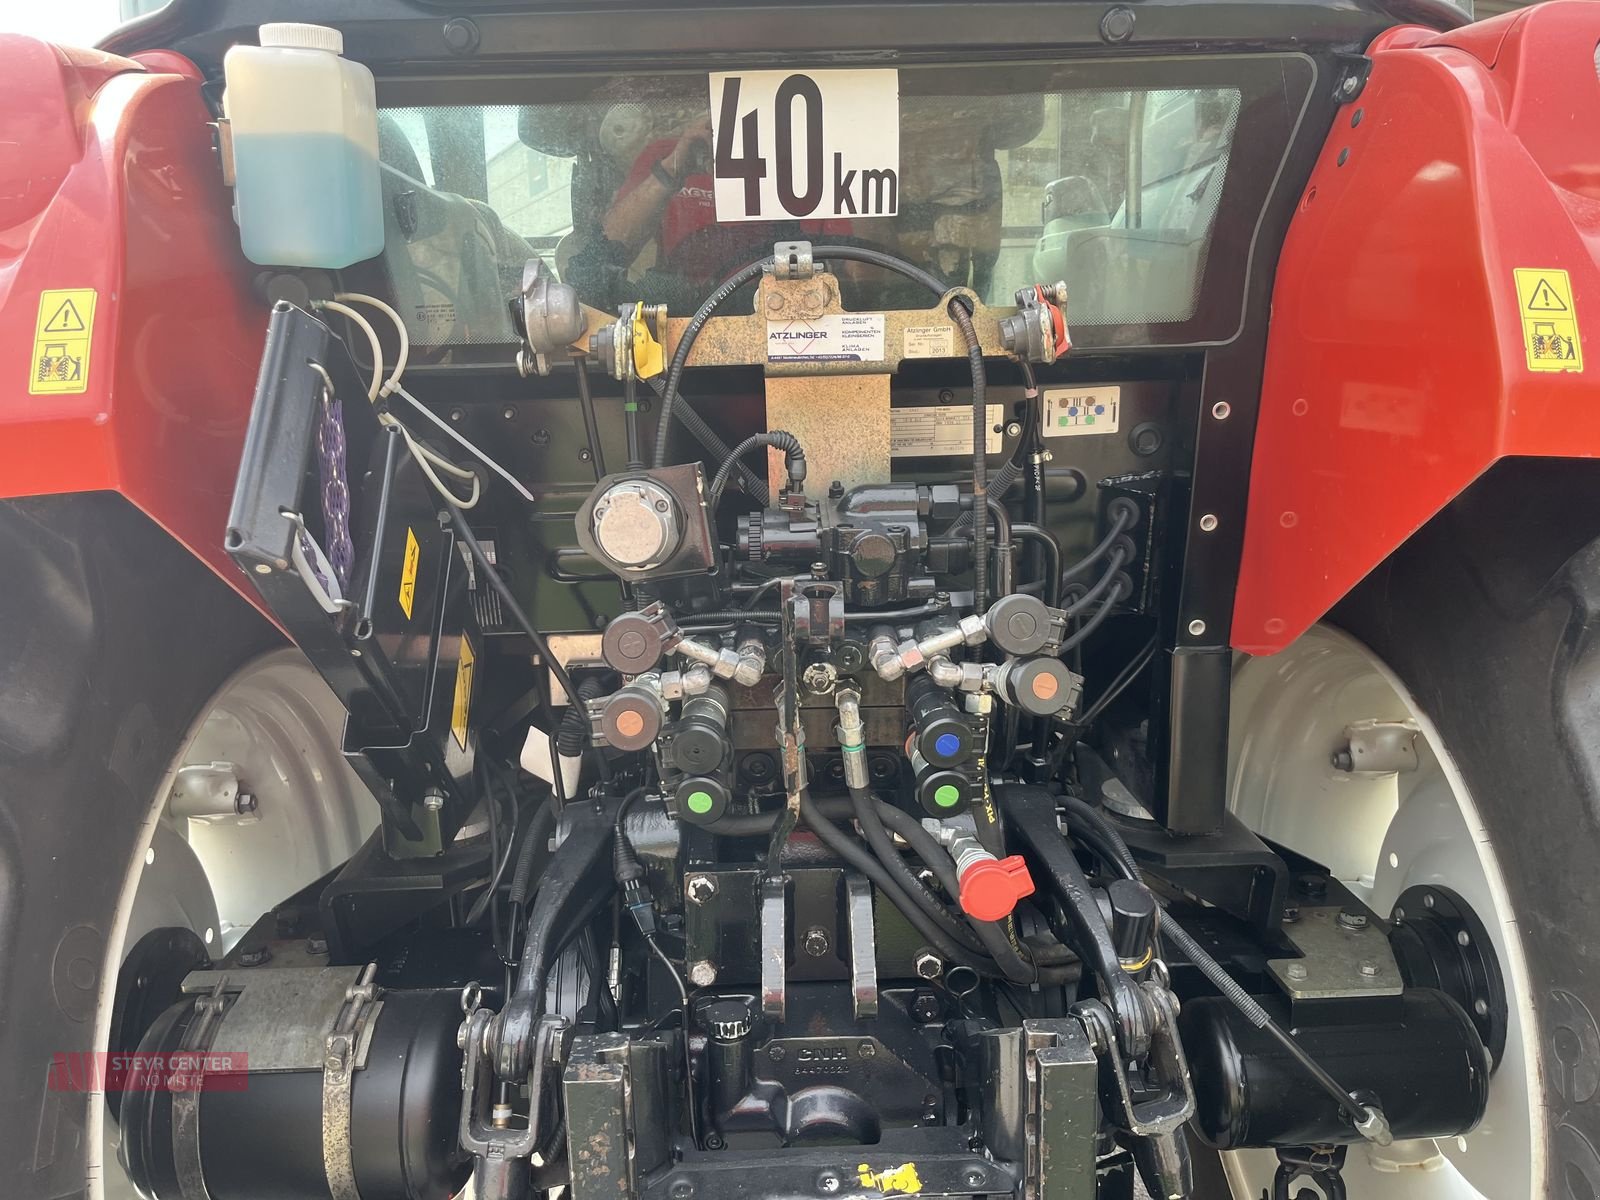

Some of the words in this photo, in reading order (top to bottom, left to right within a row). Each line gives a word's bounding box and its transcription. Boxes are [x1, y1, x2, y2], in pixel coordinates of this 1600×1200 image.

[716, 74, 823, 217] 40
[834, 152, 897, 214] km
[769, 331, 828, 340] ATZLINGER
[798, 1047, 848, 1061] CNH
